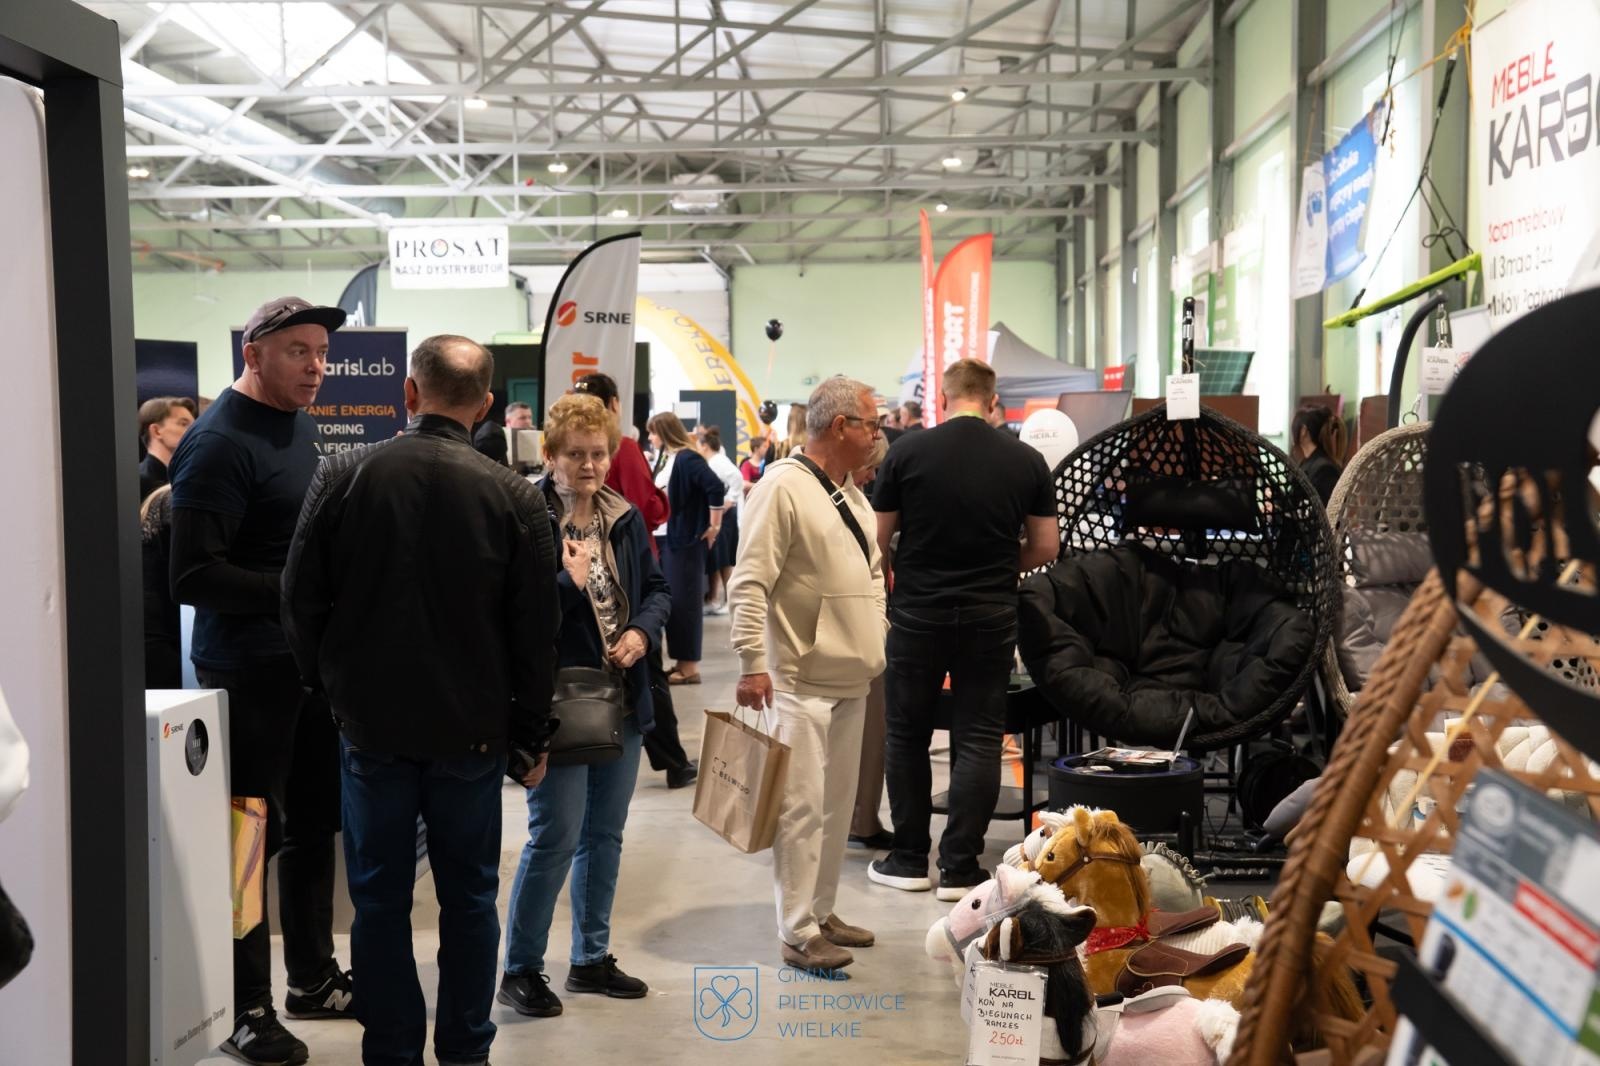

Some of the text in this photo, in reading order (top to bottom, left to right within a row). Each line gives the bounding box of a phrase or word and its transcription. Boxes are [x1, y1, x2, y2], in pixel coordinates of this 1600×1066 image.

[1490, 40, 1556, 109] MEBLE
[395, 238, 504, 258] PROSAT
[426, 263, 504, 275] DYSTRYBUTOR
[584, 311, 631, 325] SRNE
[341, 405, 396, 419] ENERGIĄ
[1002, 1001, 1014, 1009] NA
[977, 1008, 1033, 1020] BIEGUNACH
